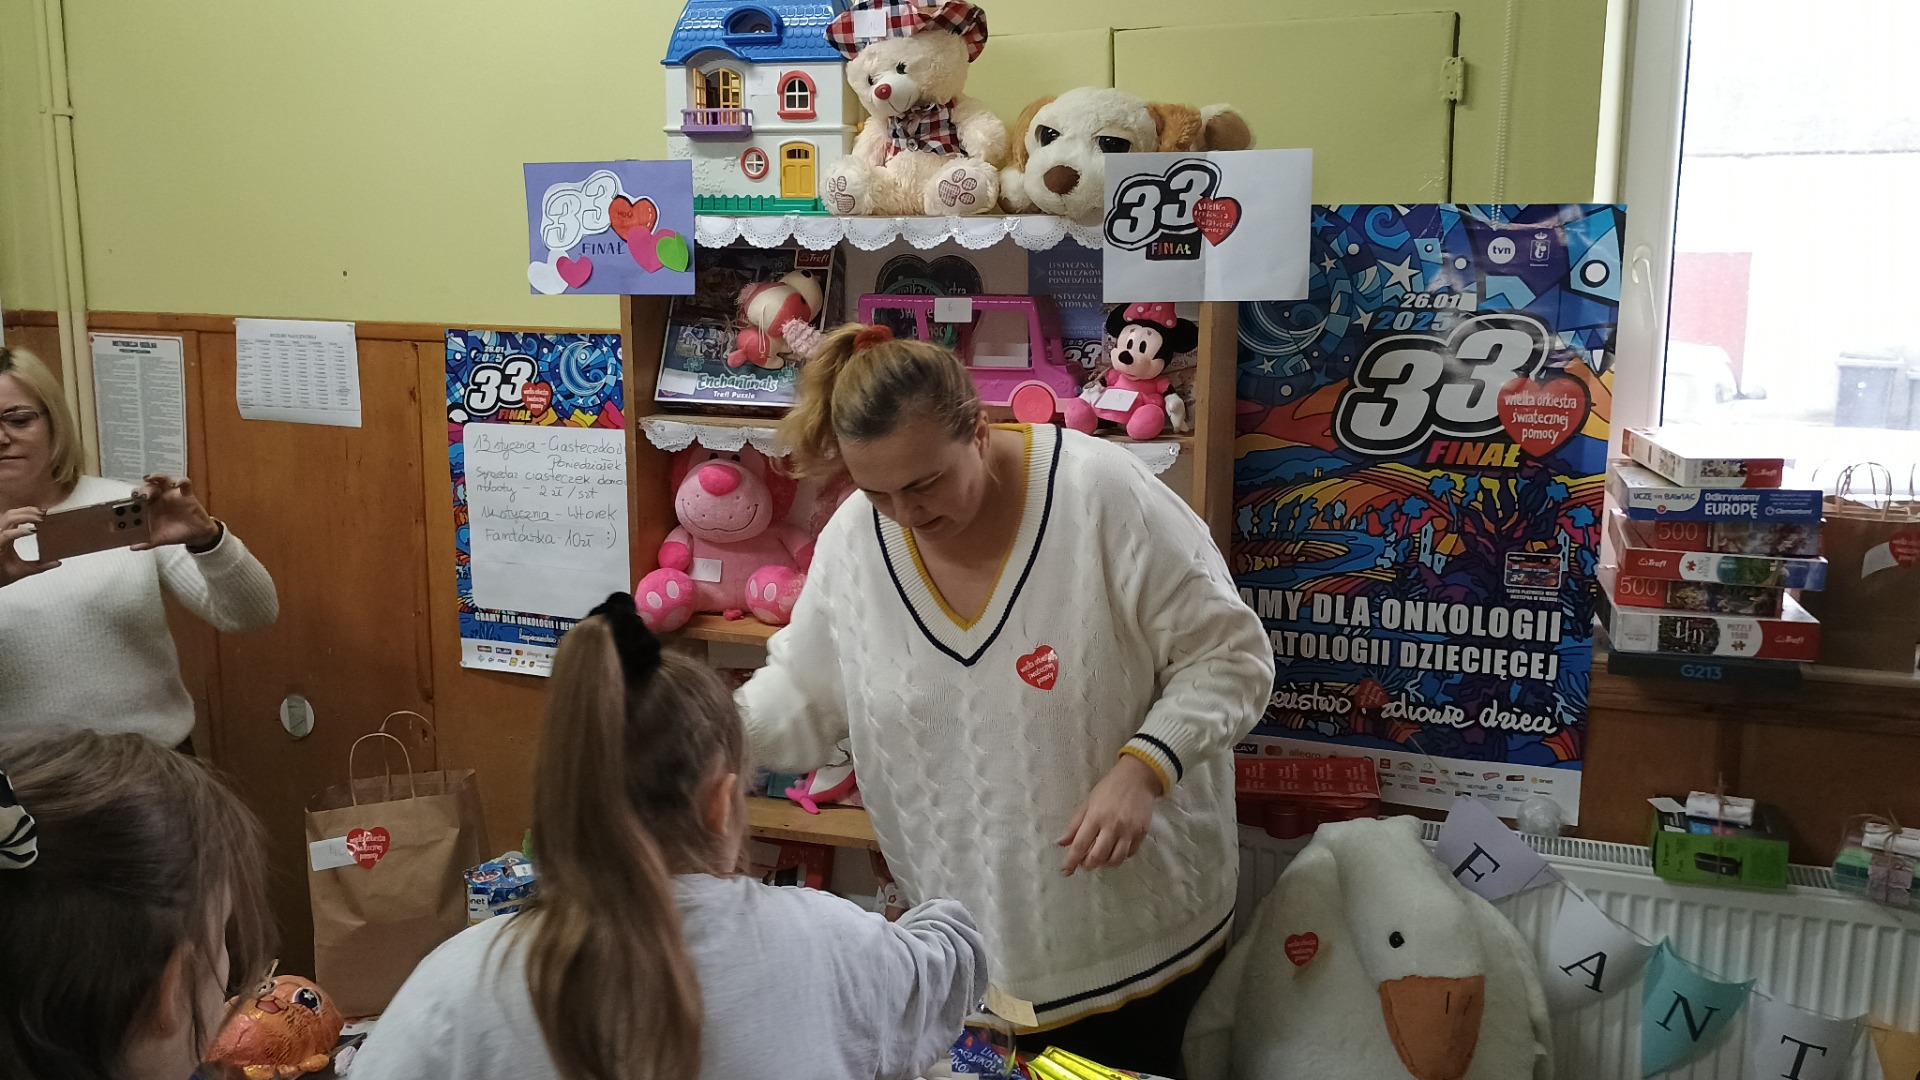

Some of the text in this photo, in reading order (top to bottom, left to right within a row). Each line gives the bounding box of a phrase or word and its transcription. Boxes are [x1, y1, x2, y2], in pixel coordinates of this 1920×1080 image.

[542, 171, 619, 249] 33
[1107, 162, 1215, 246] 33
[1150, 242, 1192, 256] FINAŁ
[1492, 245, 1512, 255] tvn
[808, 253, 830, 264] Trefl
[1401, 293, 1460, 309] 26.01
[1372, 310, 1455, 331] 2025
[473, 353, 504, 363] 2025
[467, 357, 533, 413] 33
[1346, 324, 1538, 445] 33
[731, 391, 756, 399] Puzzle
[1504, 390, 1578, 409] wielka orkiestra
[498, 408, 532, 421] FINAŁ
[1511, 408, 1569, 432] świątecznej
[473, 433, 491, 451] 13
[1521, 428, 1560, 446] pomocy
[1425, 440, 1522, 468] FINAŁ
[547, 454, 622, 473] Poniedziałek
[524, 469, 591, 485] ciasteczek
[596, 473, 628, 486] domo
[538, 484, 548, 498] 2
[577, 486, 599, 500] szt
[1633, 492, 1653, 501] UCZĘ
[567, 503, 618, 521] Wtorek
[1704, 502, 1759, 519] EUROPĘ
[1658, 521, 1698, 541] 500
[1648, 558, 1668, 569] Trefl
[1619, 579, 1659, 597] 500
[1239, 586, 1562, 643] AMY DLA ONKOLOGII
[1271, 630, 1559, 682] ATOLOGII DZIECIĘCEJ
[1680, 663, 1724, 680] G213
[1479, 699, 1558, 735] dzieci
[1453, 842, 1828, 1080] F A N T
